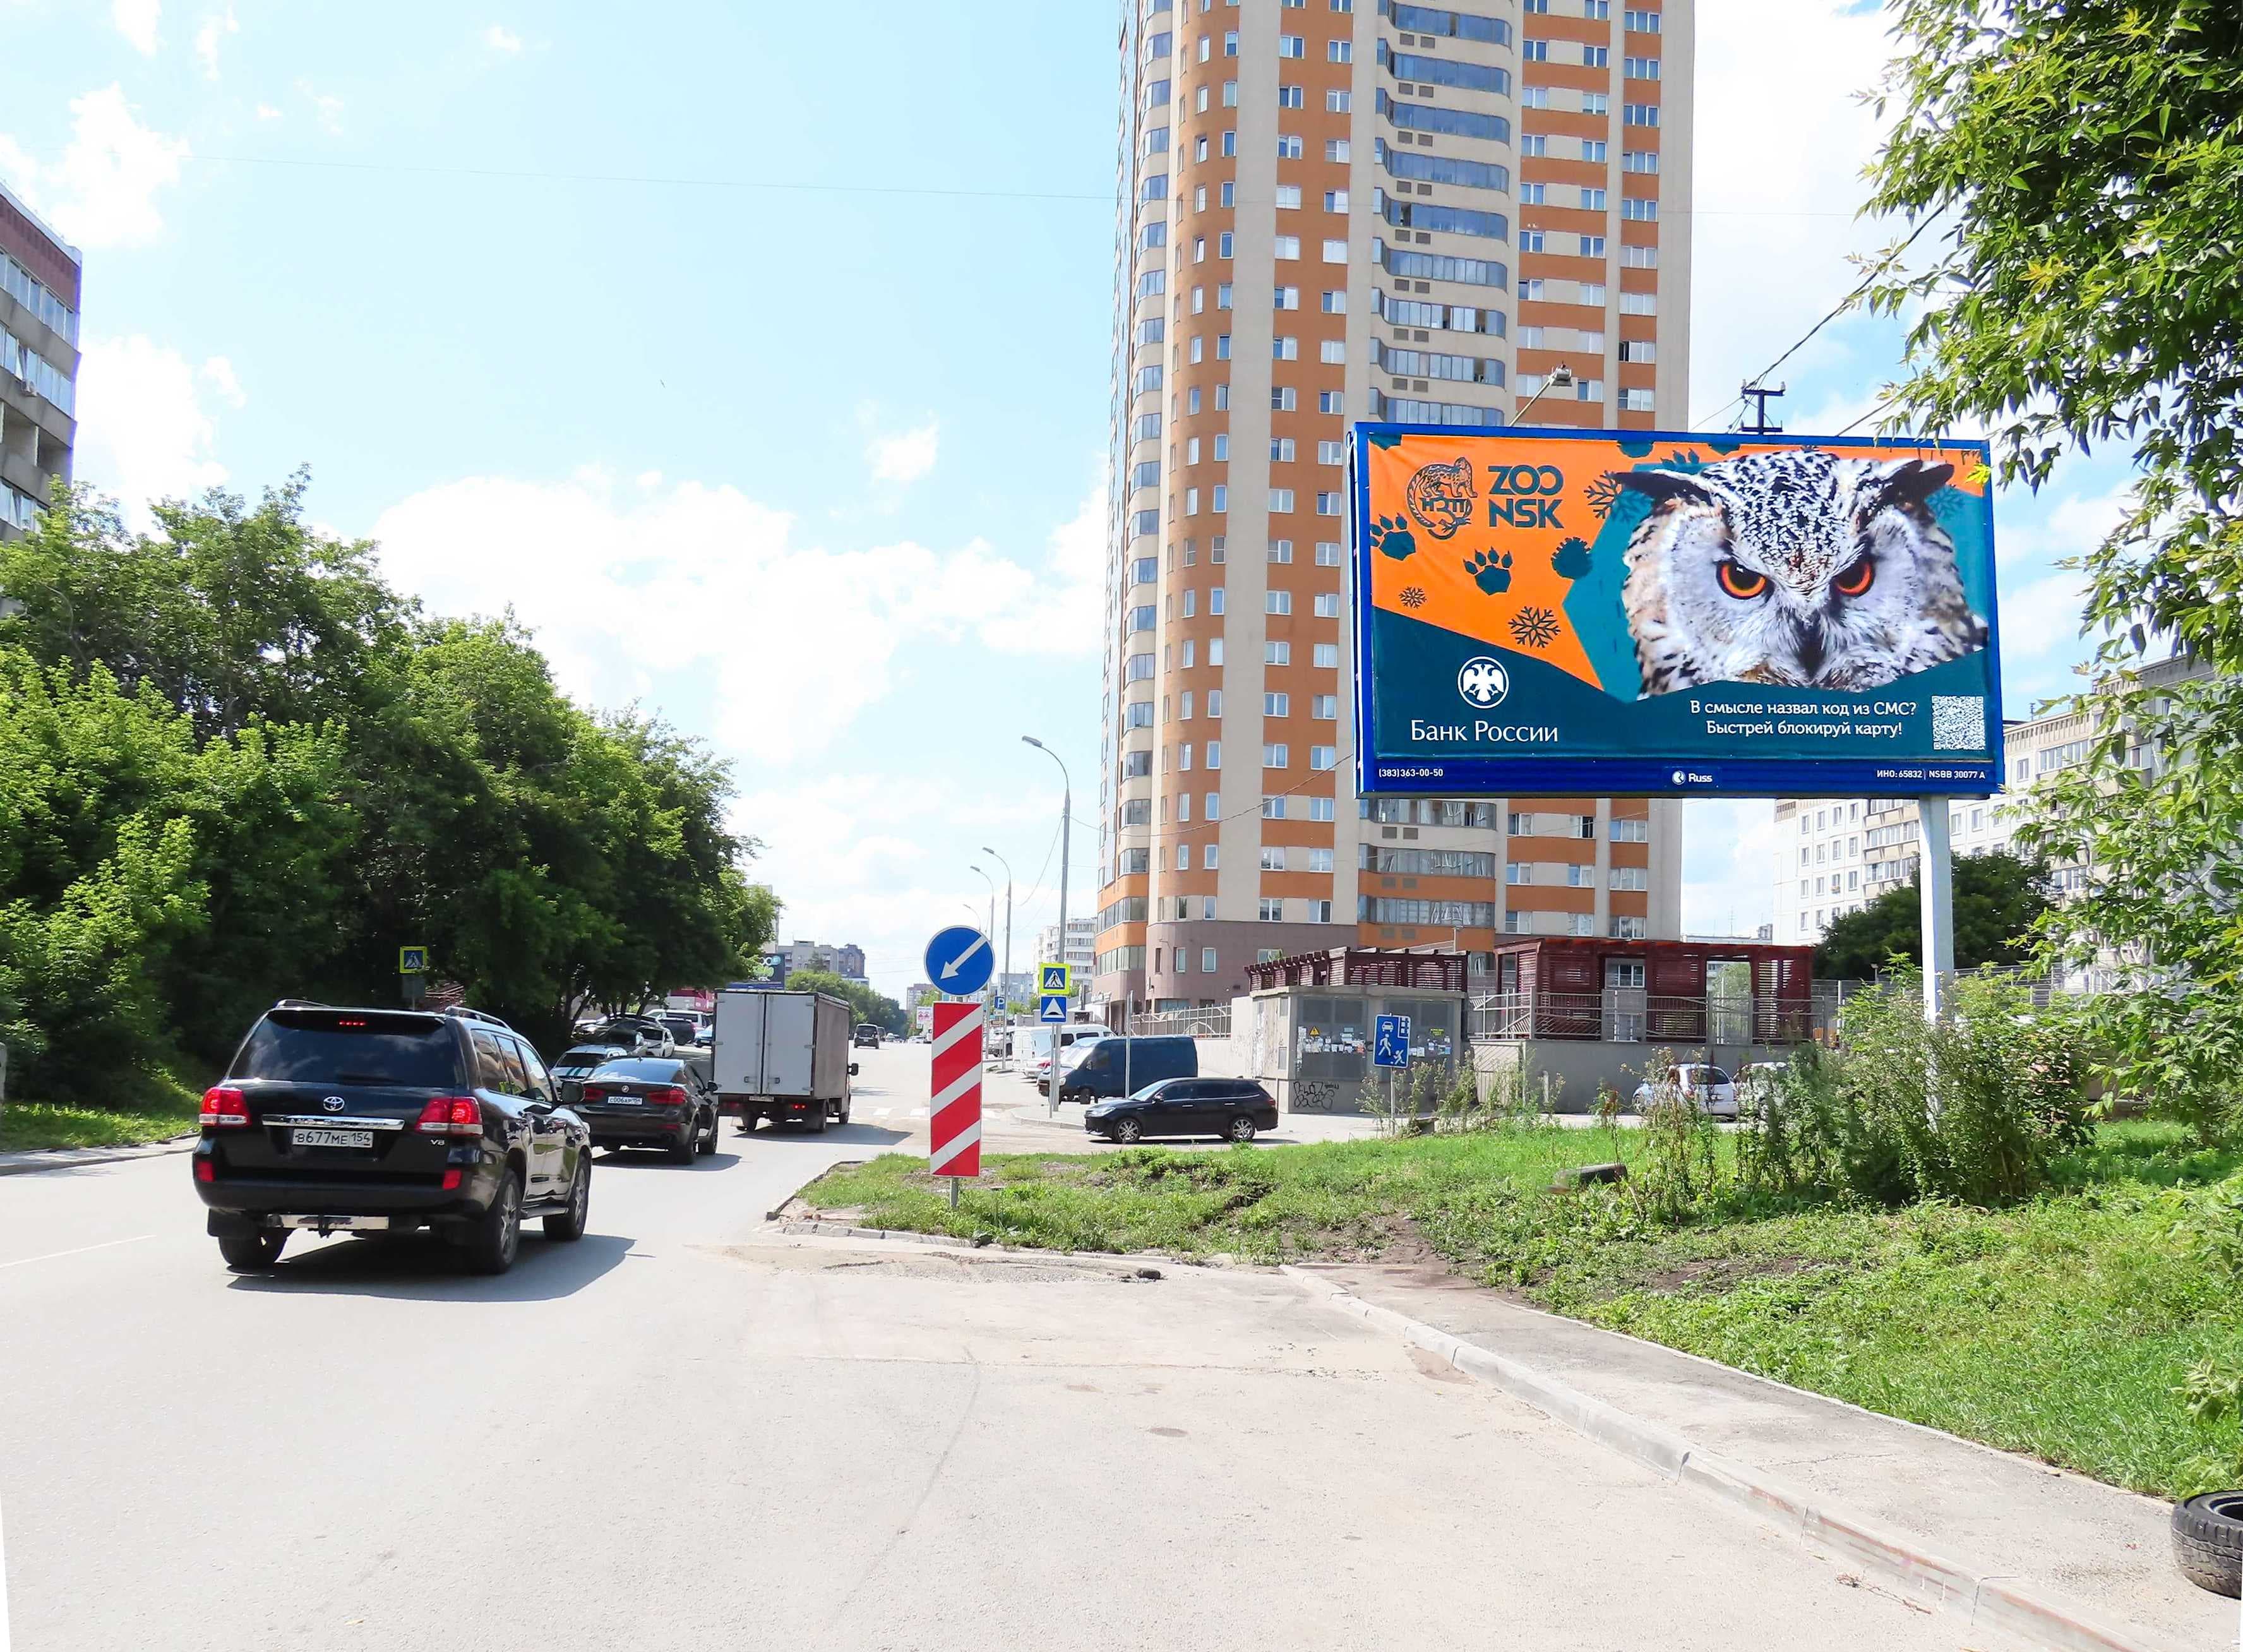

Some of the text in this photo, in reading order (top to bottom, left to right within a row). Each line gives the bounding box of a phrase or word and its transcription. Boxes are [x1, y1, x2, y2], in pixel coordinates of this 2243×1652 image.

[1488, 465, 1564, 496] ZOO
[1488, 498, 1565, 529] NSK
[1690, 700, 1917, 717] В смысле назвал код из СМС?
[1411, 719, 1558, 742] Банк России
[1706, 720, 1902, 738] Быстрей блокируй карту!
[1688, 773, 1713, 782] Russ
[353, 1132, 371, 1142] 154
